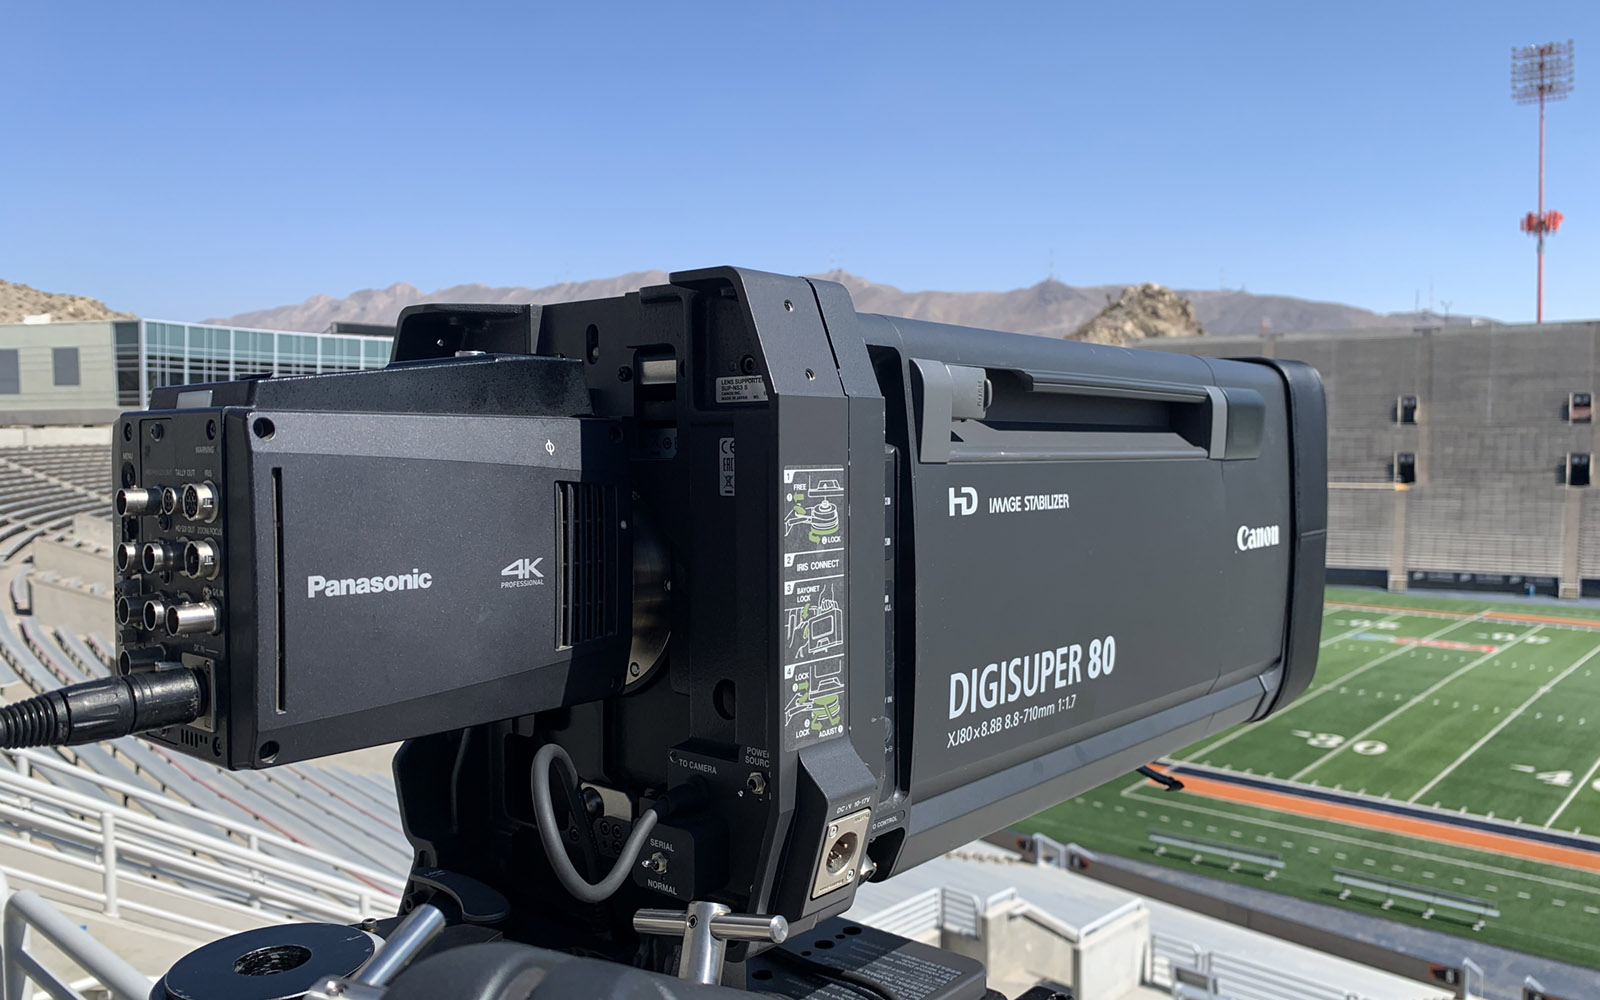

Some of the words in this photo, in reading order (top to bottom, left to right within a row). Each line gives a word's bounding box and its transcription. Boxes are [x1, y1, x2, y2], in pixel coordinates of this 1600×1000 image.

[948, 486, 979, 517] HD
[989, 496, 1022, 514] IMAGE
[1024, 493, 1070, 512] STABILIZER
[1236, 524, 1280, 551] Canon
[501, 557, 544, 579] 4K
[797, 561, 808, 572] IRIS
[810, 559, 839, 570] CONNECT
[308, 568, 432, 598] Panasonic
[500, 579, 544, 589] PROFESSIONAL
[797, 585, 820, 594] BAYONET
[797, 595, 811, 603] LOCK
[795, 672, 809, 682] LOCK
[948, 643, 1082, 720] DIGISUPER
[1087, 635, 1116, 680] 80
[1004, 703, 1055, 730] 8.8-710mm
[1058, 694, 1077, 713] 1:1.7
[796, 729, 810, 738] LOCK
[818, 727, 837, 738] ADJUST
[679, 759, 688, 767] TO
[689, 761, 717, 774] CAMERA
[836, 805, 845, 814] DC
[877, 816, 898, 828] CONTROL
[650, 838, 675, 852] SERIAL
[648, 879, 677, 895] NORMAL
